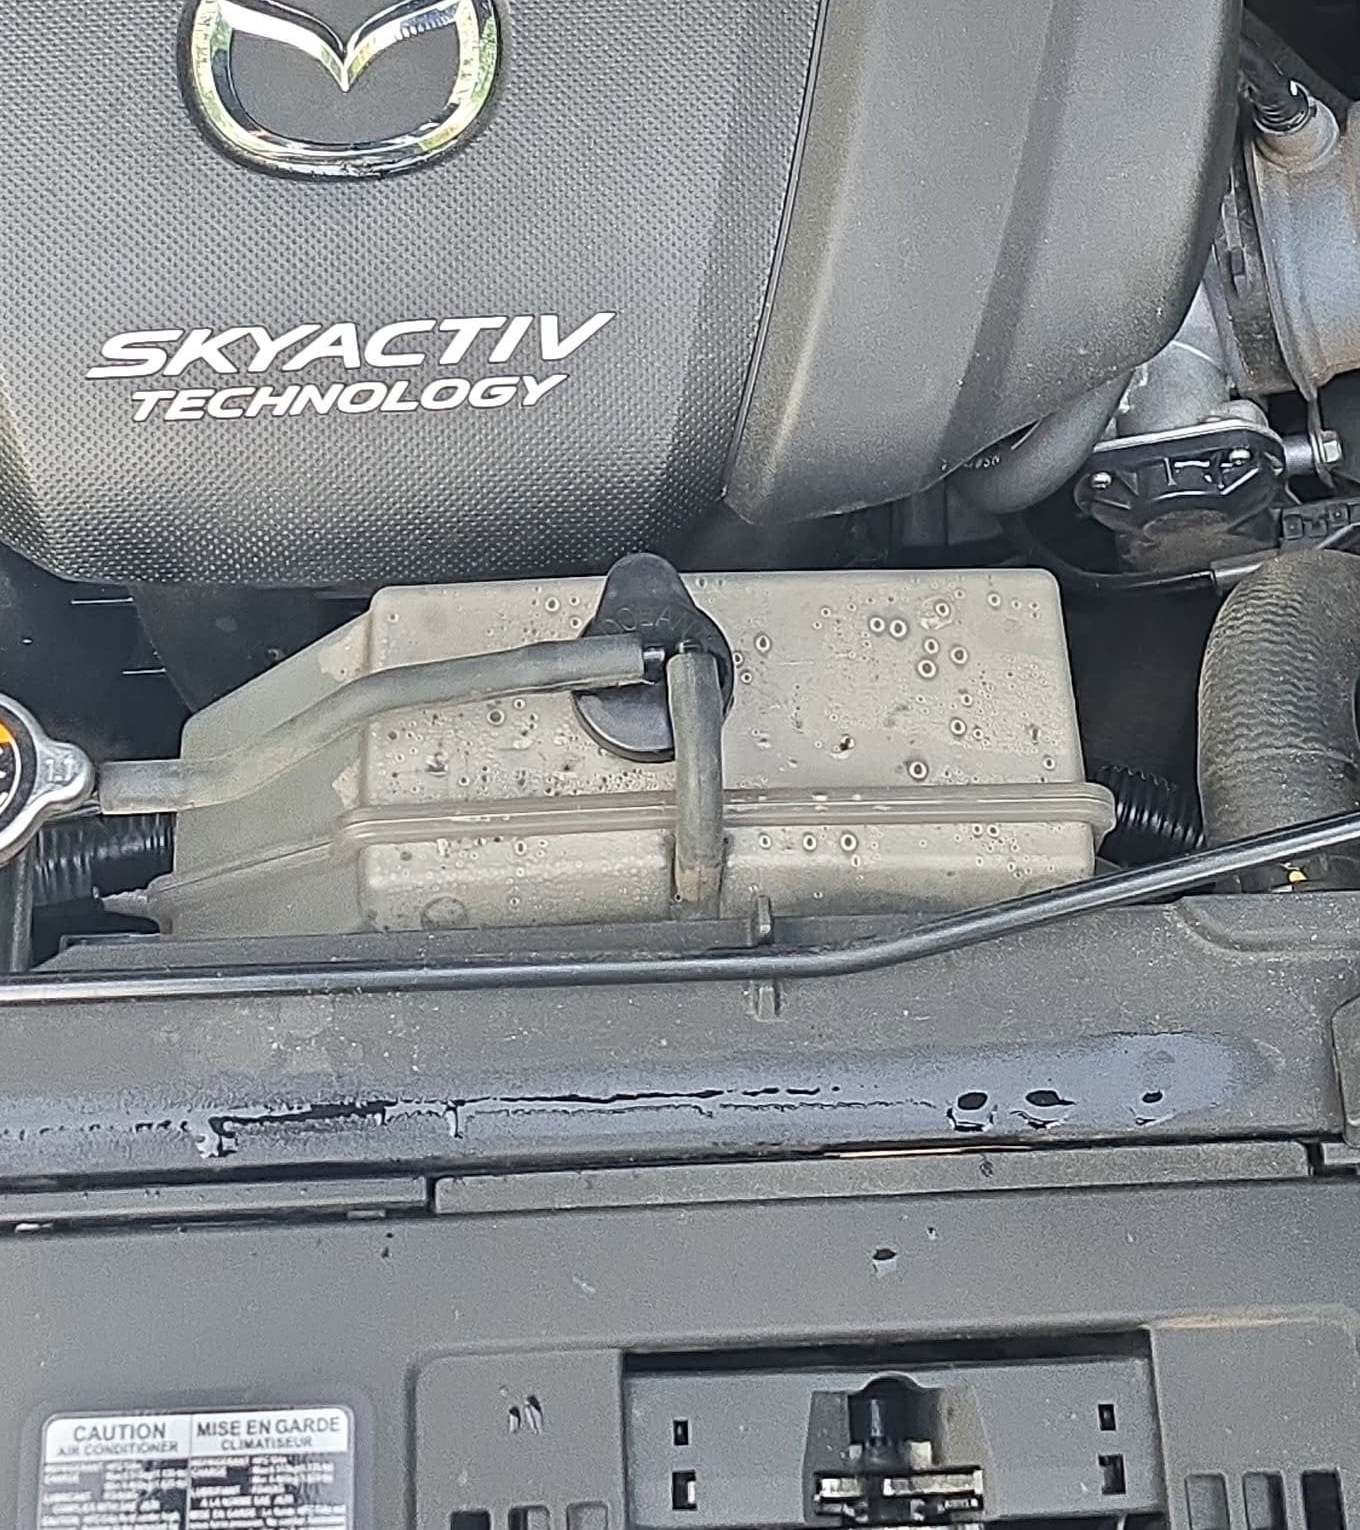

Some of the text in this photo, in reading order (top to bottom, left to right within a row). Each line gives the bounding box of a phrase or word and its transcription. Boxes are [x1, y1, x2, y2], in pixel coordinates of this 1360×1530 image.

[86, 311, 617, 379] SKYACTIV
[131, 374, 567, 422] TECHNOLOGY
[73, 1422, 166, 1442] CAUTION
[196, 1415, 341, 1438] MISE EN GARDE
[57, 1441, 179, 1457] AIR CONDITIONER
[221, 1435, 313, 1452] CLIMATISEUR
